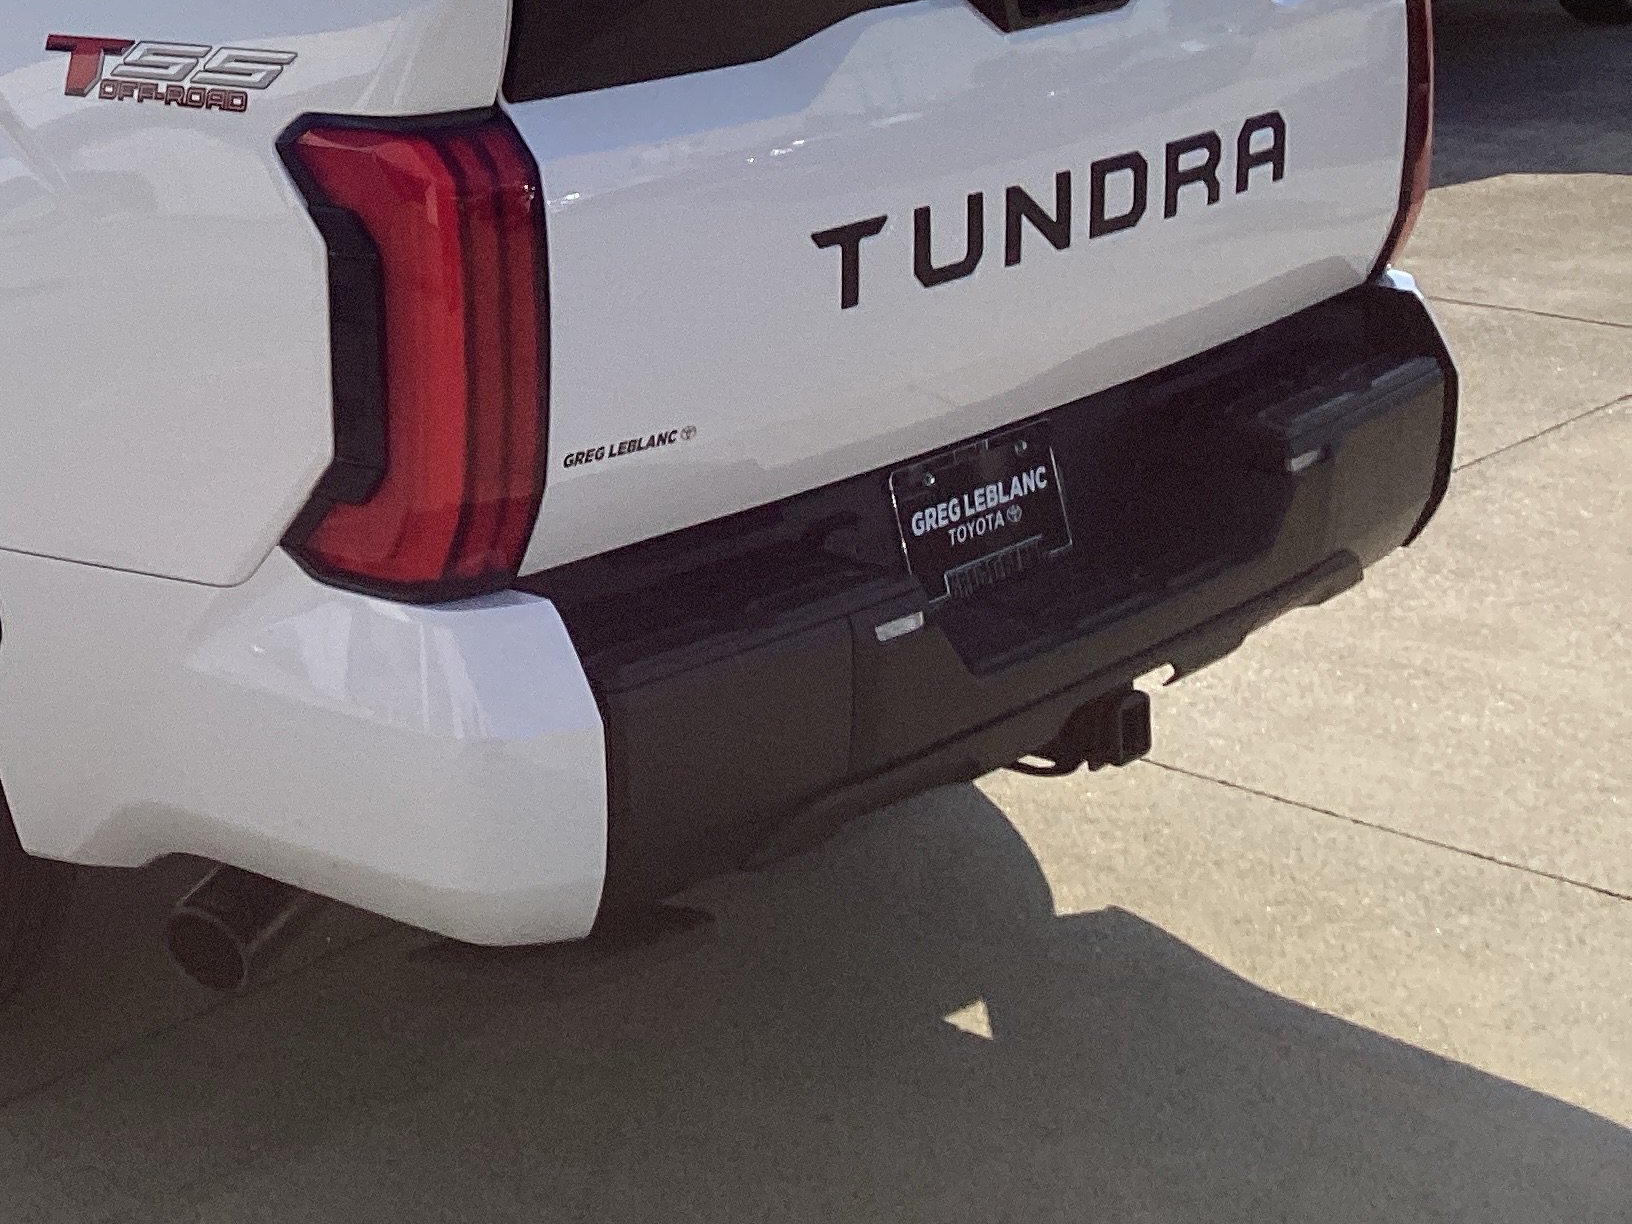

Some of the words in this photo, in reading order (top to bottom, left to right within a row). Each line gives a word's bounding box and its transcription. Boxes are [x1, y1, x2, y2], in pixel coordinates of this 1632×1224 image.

[45, 33, 298, 98] TSS
[98, 78, 248, 113] OFF-ROAD
[810, 109, 1287, 310] TUNDRA
[562, 446, 606, 469] GREG
[607, 429, 679, 459] LEBLANC
[910, 496, 962, 537] GREG
[962, 465, 1048, 518] LEBLANC
[947, 509, 1006, 547] TOYOTA
